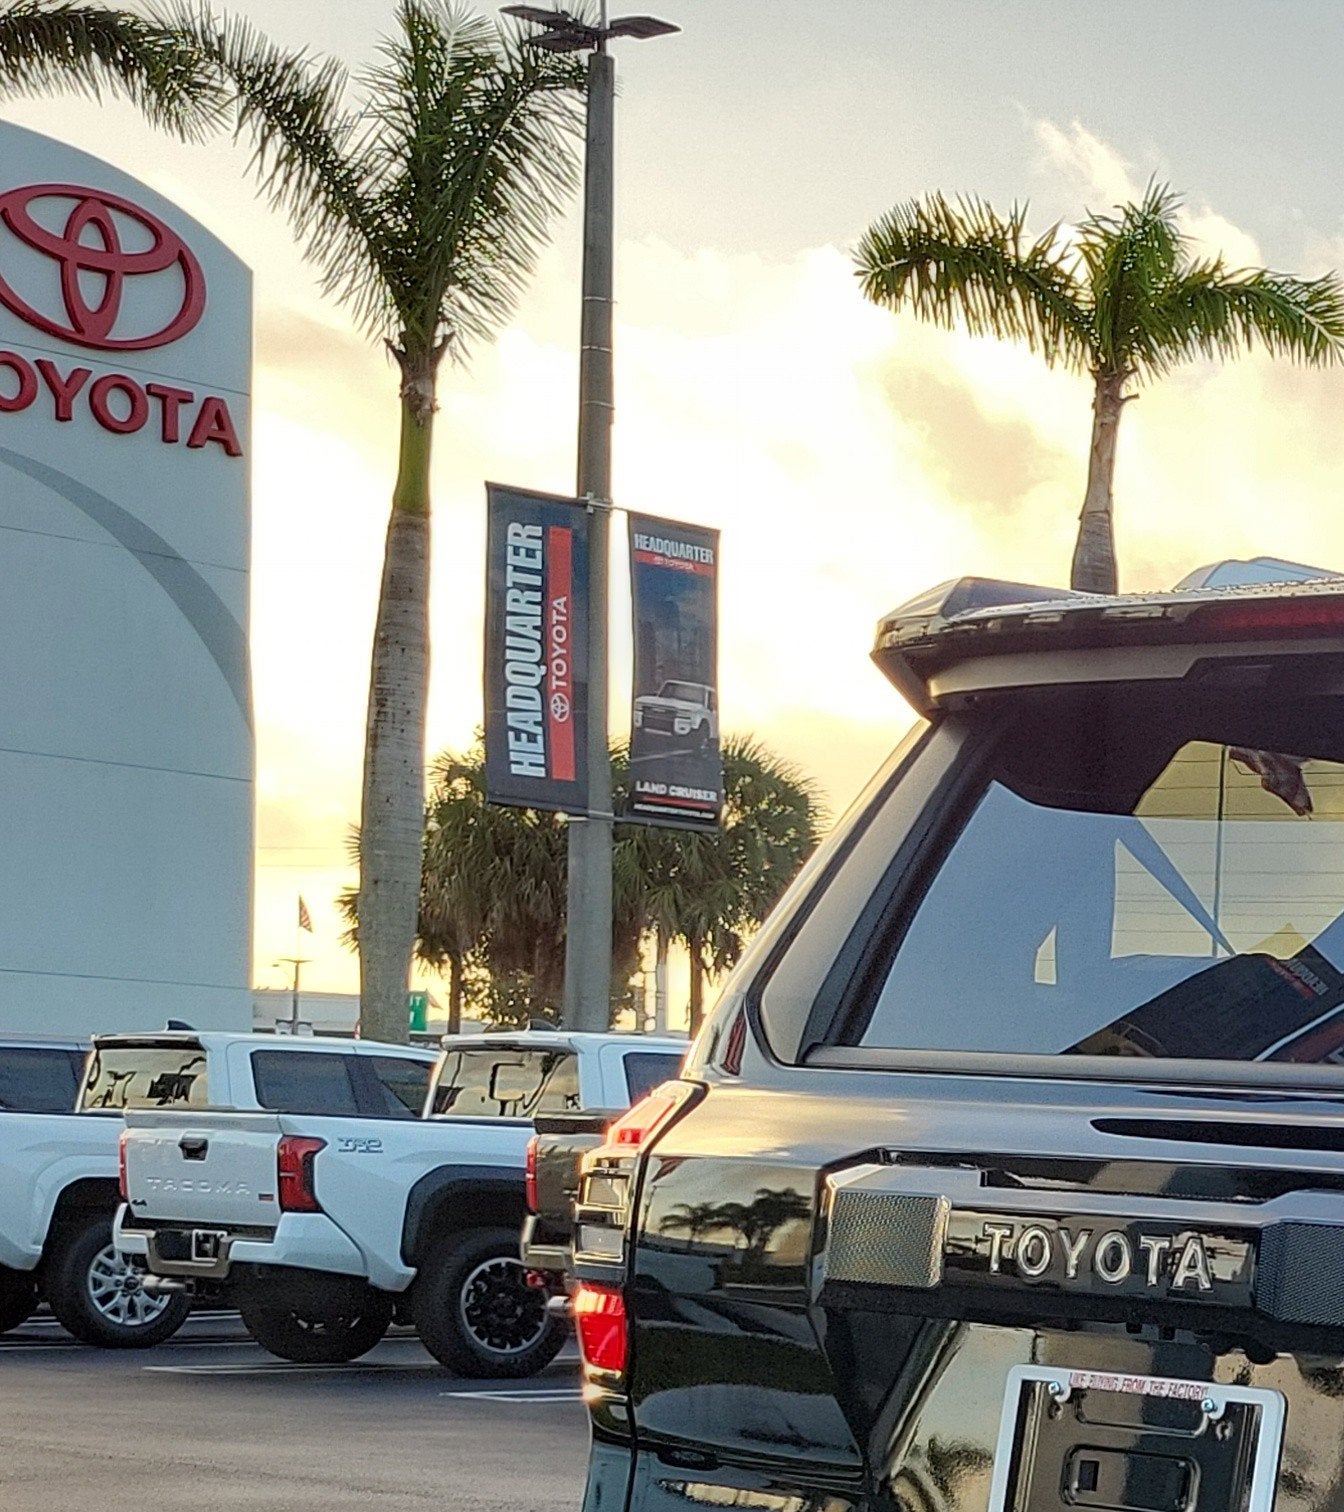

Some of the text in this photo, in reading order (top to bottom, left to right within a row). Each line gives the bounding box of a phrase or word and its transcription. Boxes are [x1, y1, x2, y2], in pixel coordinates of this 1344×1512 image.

[0, 350, 243, 456] OYOTA
[634, 533, 714, 565] HEADQUARTER
[505, 522, 547, 778] HEADQUARTER
[552, 596, 568, 690] TOYOTA
[635, 780, 718, 802] LAND CRUISER
[147, 1176, 251, 1195] TACOMA
[983, 1222, 1213, 1292] TOYOTA
